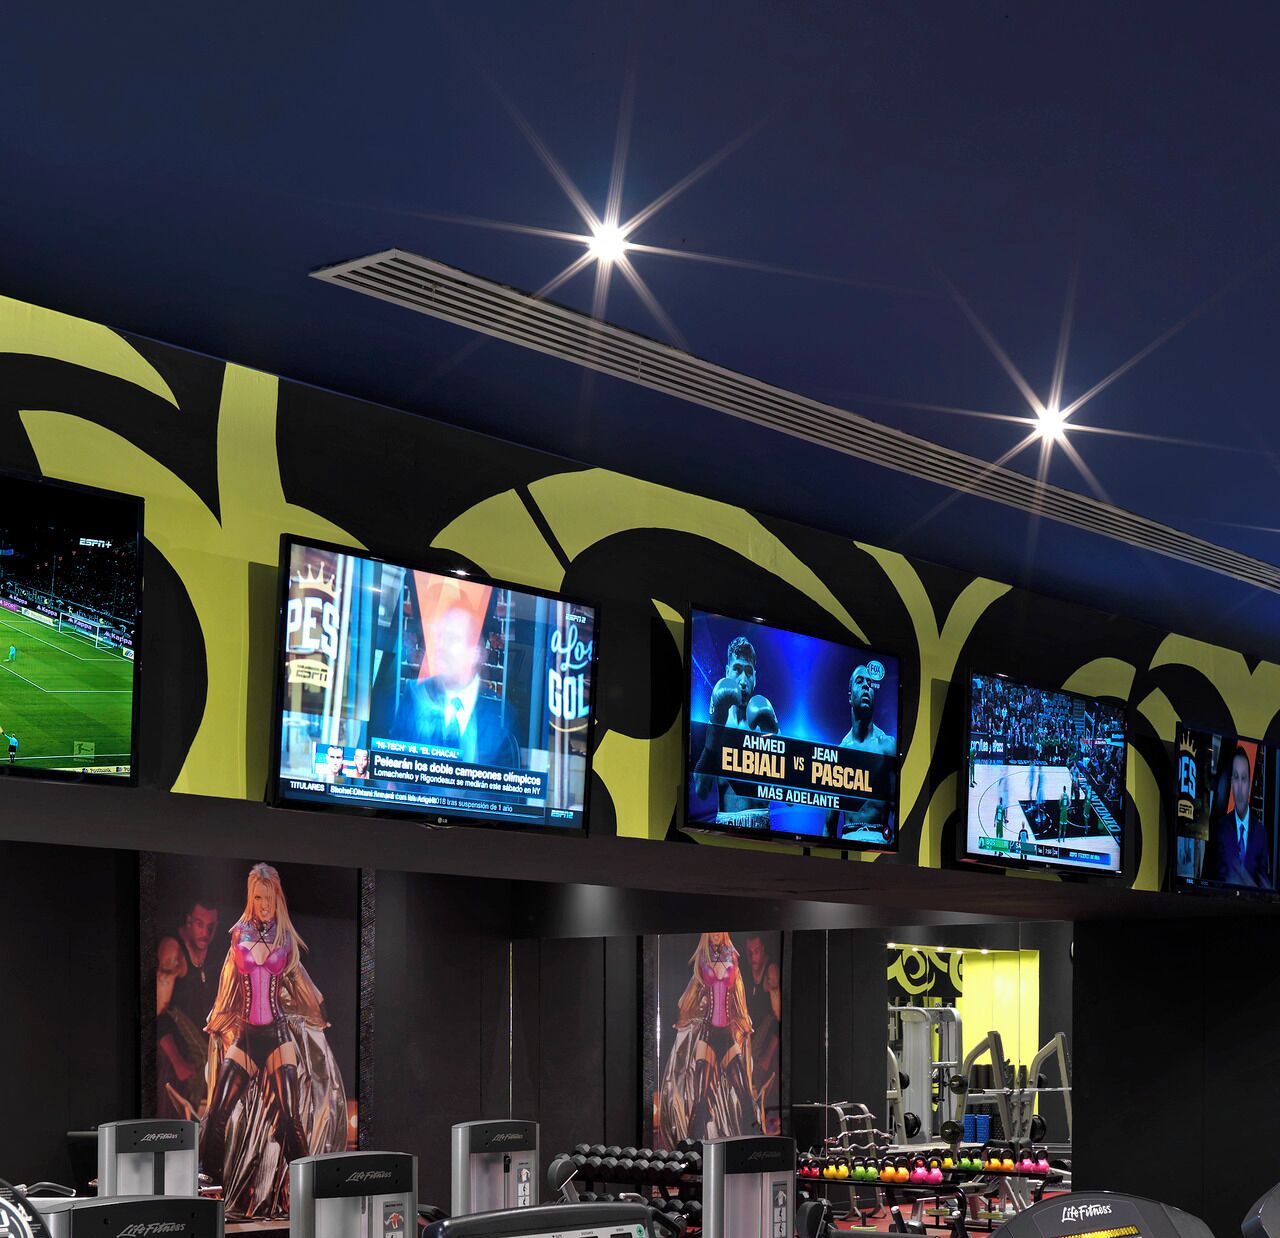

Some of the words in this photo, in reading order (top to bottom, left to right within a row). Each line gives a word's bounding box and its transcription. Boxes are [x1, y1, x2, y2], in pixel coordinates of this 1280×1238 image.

[79, 537, 112, 549] ESPN+
[742, 734, 786, 754] AHMED
[812, 747, 838, 763] JEAN
[415, 760, 428, 774] los
[430, 762, 453, 776] doble
[455, 767, 502, 784] campeones
[504, 769, 540, 787] olímpicos
[721, 746, 785, 779] ELBIALI
[793, 756, 805, 771] VS
[811, 761, 872, 793] PASCAL
[1179, 756, 1196, 799] ES
[290, 781, 325, 793] TITULARES
[786, 788, 840, 809] ADELANTE
